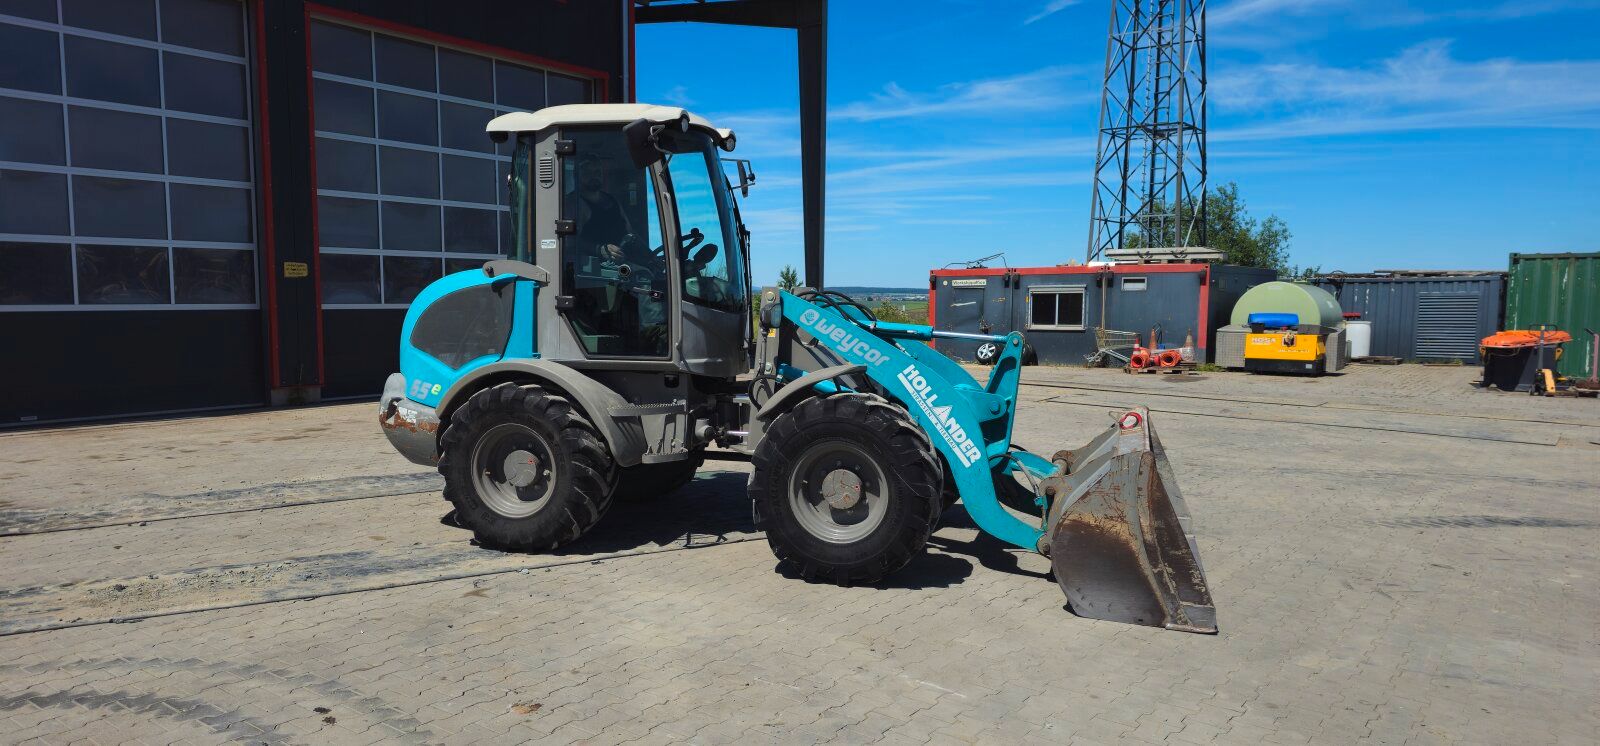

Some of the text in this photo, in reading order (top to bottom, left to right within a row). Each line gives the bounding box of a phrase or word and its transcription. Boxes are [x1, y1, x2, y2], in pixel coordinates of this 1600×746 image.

[814, 318, 890, 367] weycor
[902, 364, 981, 464] HOLLANDER
[939, 427, 957, 449] TIEFBAU
